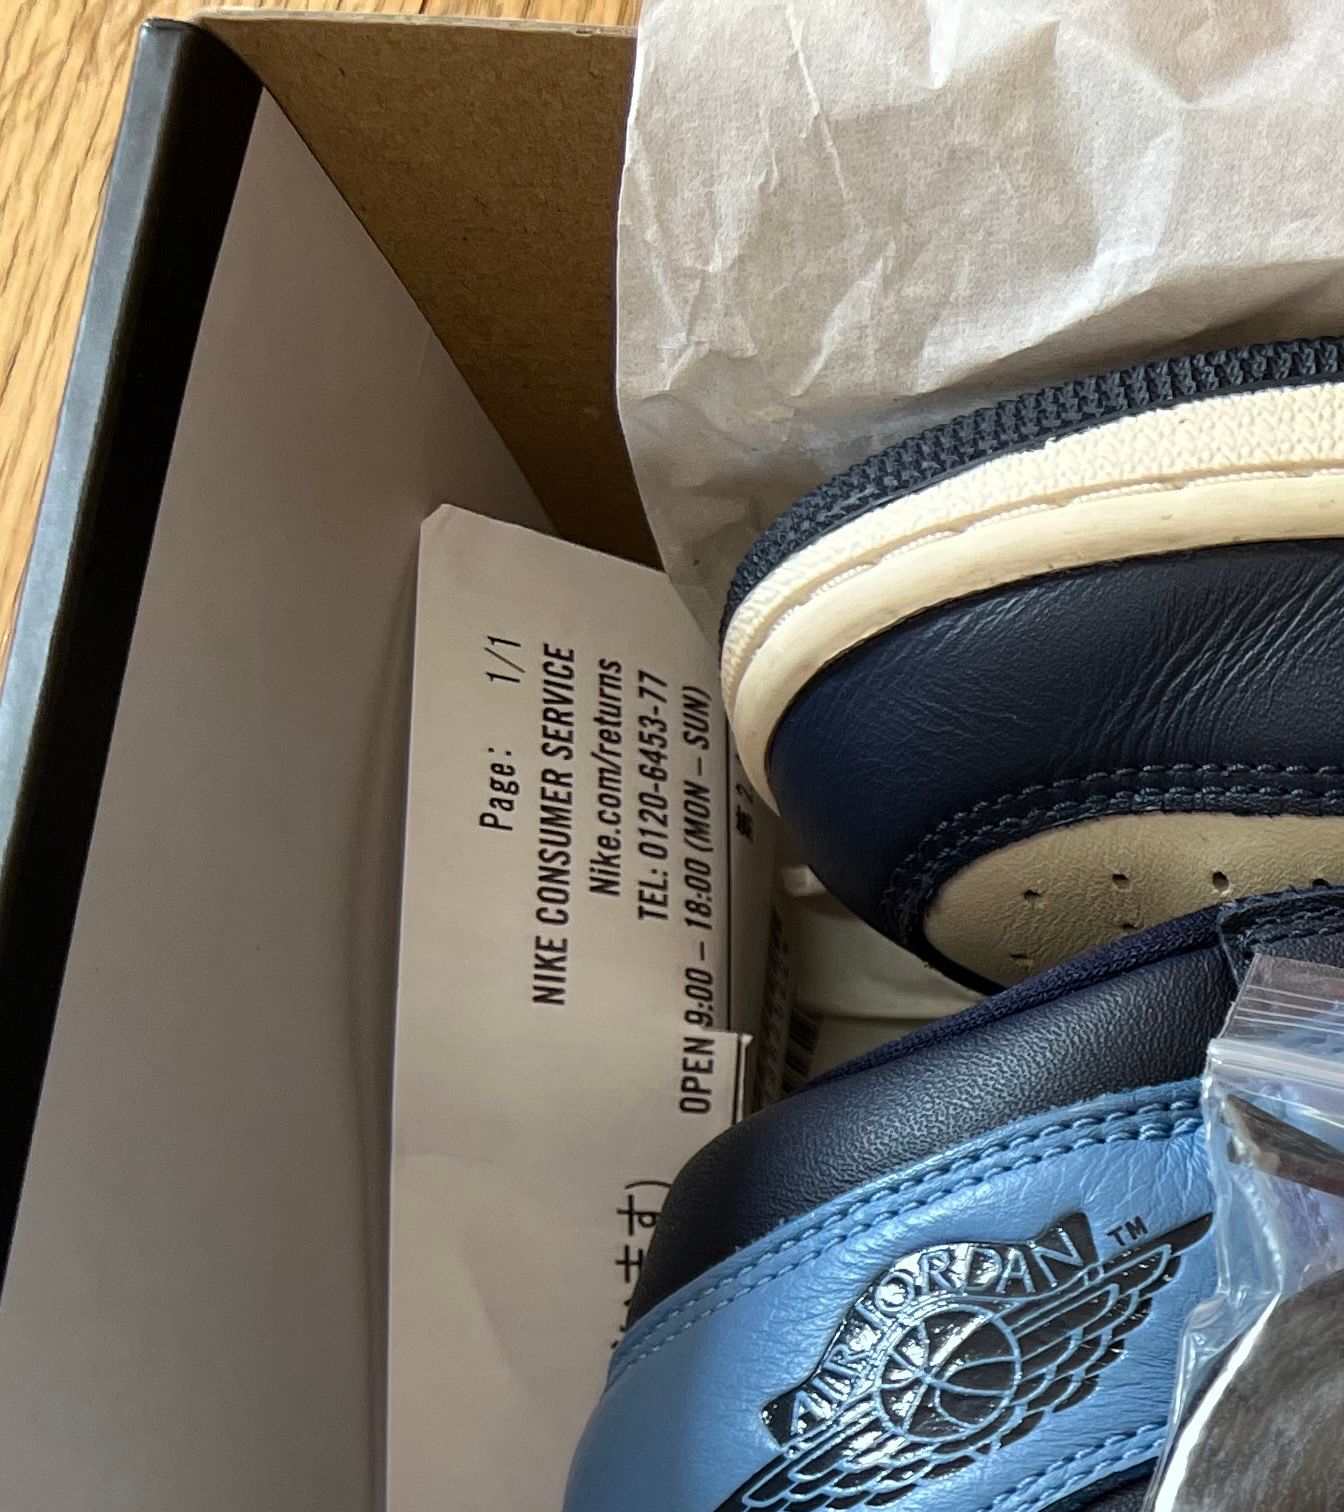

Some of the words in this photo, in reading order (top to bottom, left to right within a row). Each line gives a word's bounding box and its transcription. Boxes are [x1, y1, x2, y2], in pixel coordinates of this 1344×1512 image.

[485, 636, 524, 682] 1/1
[541, 643, 574, 760] SERVICE
[683, 686, 711, 750] SUN)
[479, 748, 519, 830] Page:
[590, 659, 622, 896] Nike.com/returns
[638, 670, 667, 859] 0120-6453-77
[536, 769, 572, 925] CONSUMER
[684, 780, 713, 852] (MON
[638, 869, 668, 919] TEL:
[684, 858, 712, 930] 18:00
[532, 936, 567, 1005] NIKE
[685, 968, 714, 1027] 9:00
[679, 1037, 714, 1114] OPEN
[793, 1341, 873, 1434] AIR
[854, 1228, 1086, 1331] JORDAN
